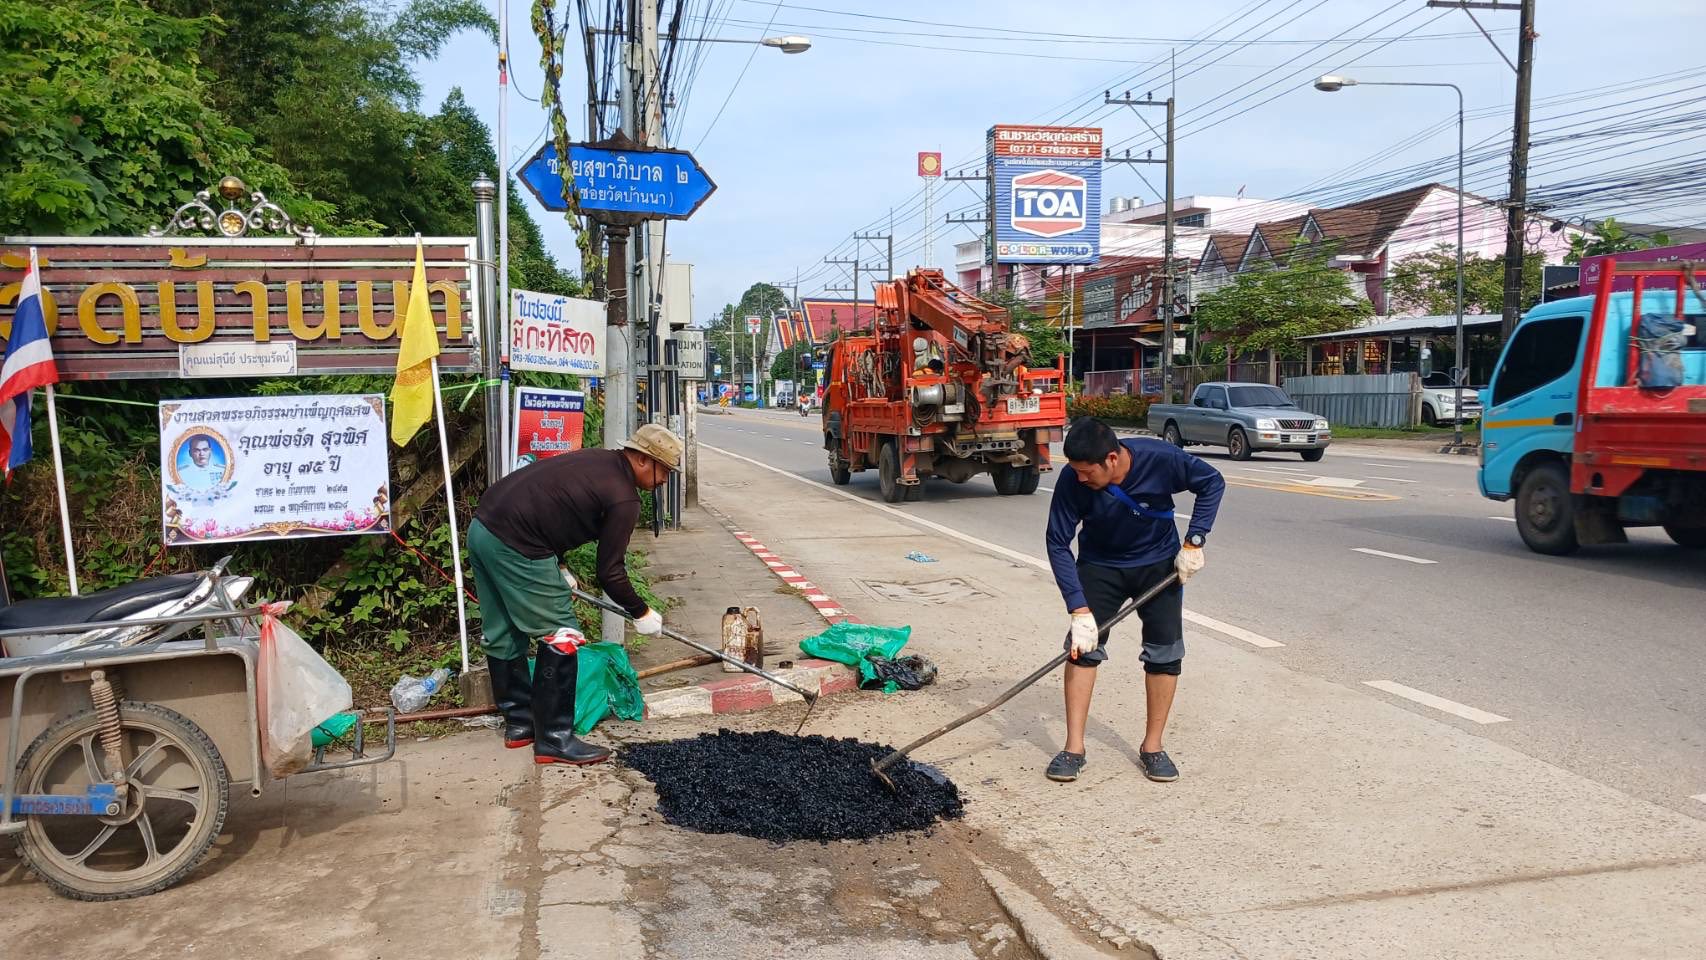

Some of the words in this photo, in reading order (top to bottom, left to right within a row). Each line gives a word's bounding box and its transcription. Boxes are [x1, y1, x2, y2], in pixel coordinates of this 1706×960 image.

[1009, 144, 1036, 153] (077)
[547, 155, 664, 187] ซยสุขาภิบาล
[1017, 190, 1080, 217] TOA
[1000, 244, 1047, 255] COLOR
[1051, 246, 1089, 256] WORLD
[263, 462, 293, 481] อายุ
[298, 460, 326, 475] ๗๕
[328, 454, 342, 472] ปี
[254, 504, 274, 514] มรณะ
